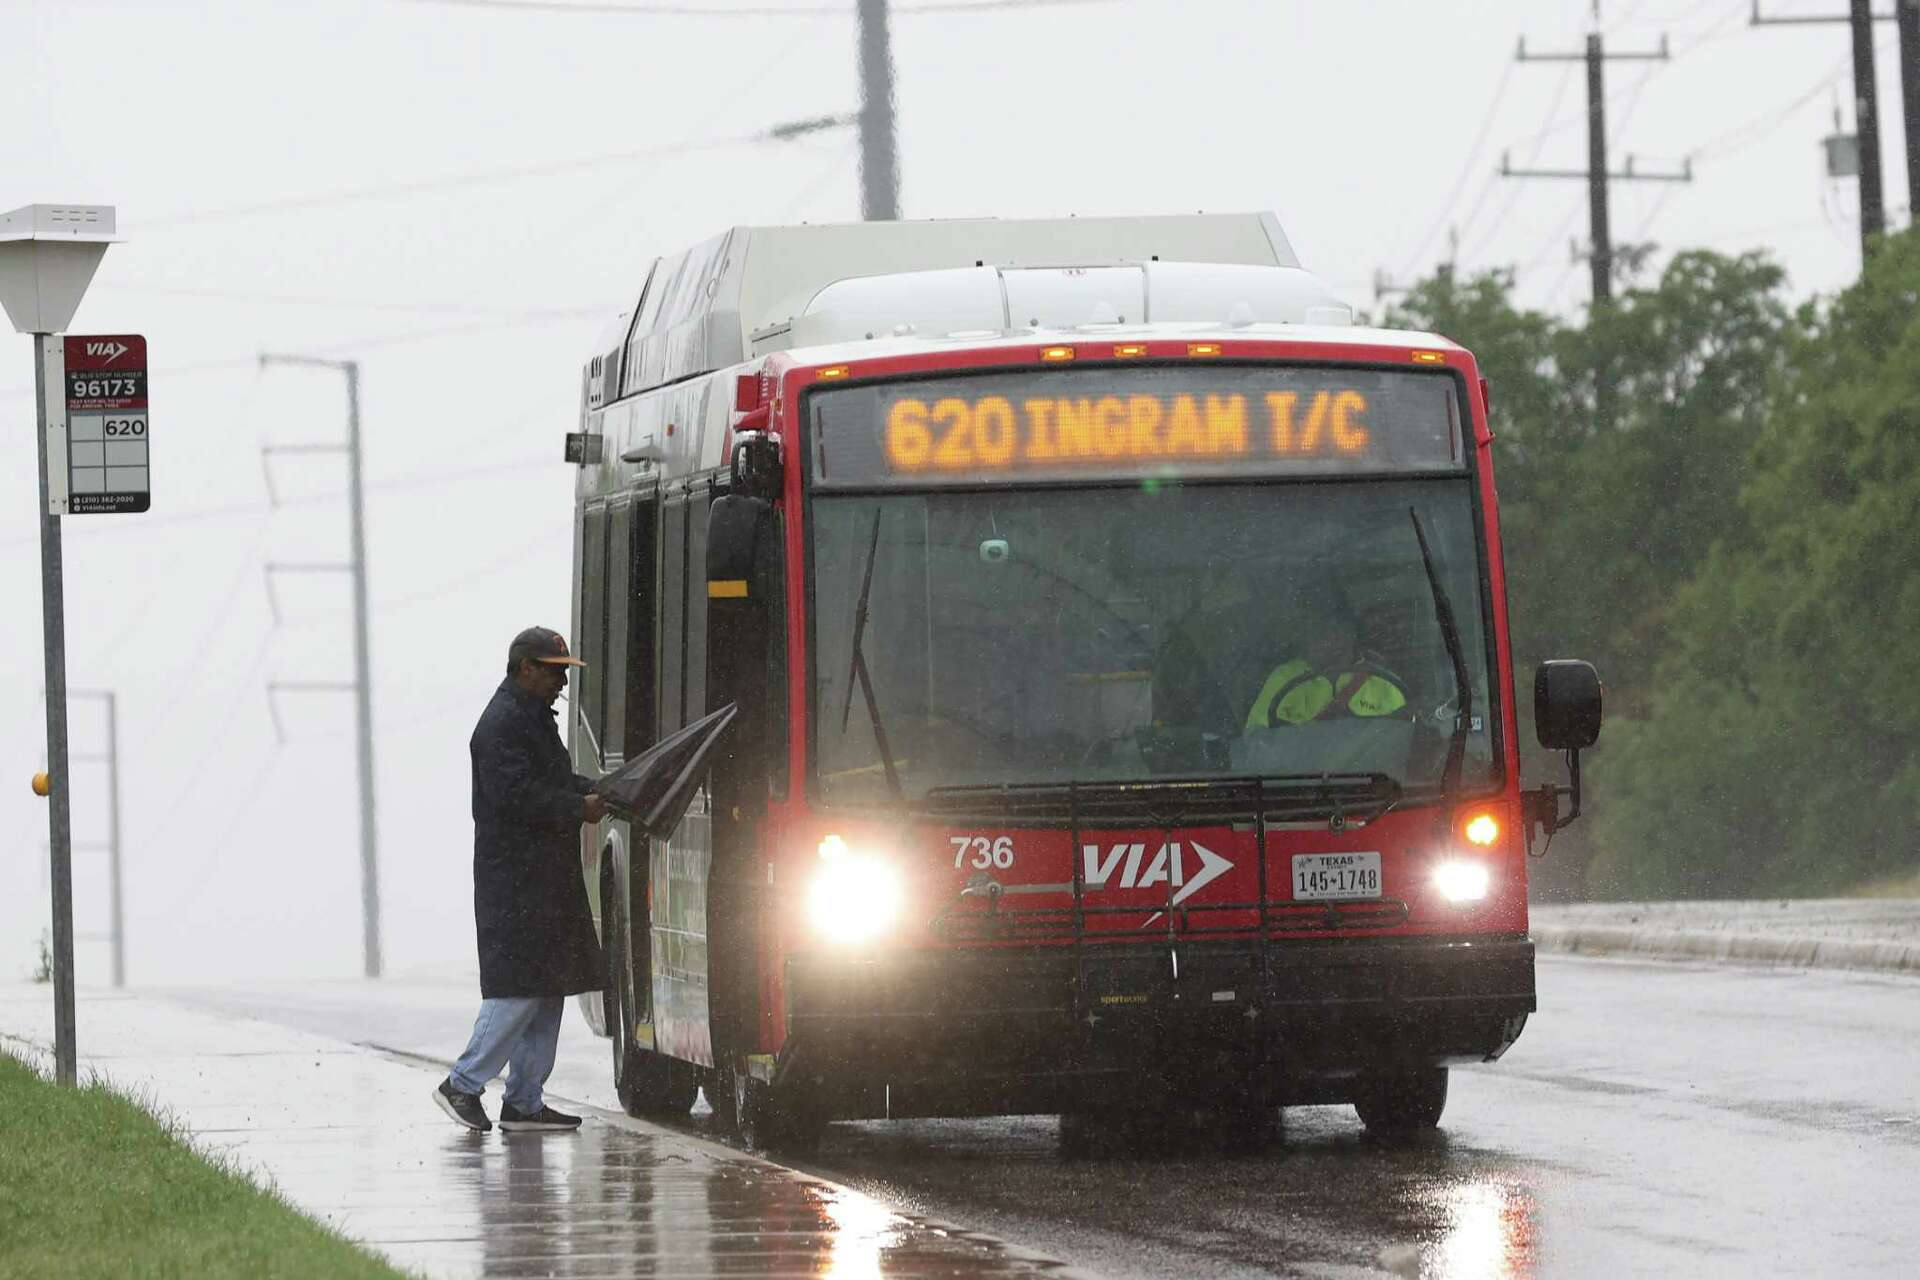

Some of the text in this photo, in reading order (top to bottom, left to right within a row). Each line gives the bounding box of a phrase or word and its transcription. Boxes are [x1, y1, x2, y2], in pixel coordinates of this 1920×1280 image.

[86, 342, 115, 356] VIA
[74, 379, 136, 397] 96173
[105, 420, 145, 436] 620
[887, 388, 1369, 467] 620 INGRAM T/C
[950, 836, 1014, 870] 736
[1319, 856, 1354, 866] TEXAS
[1082, 842, 1183, 888] VIA
